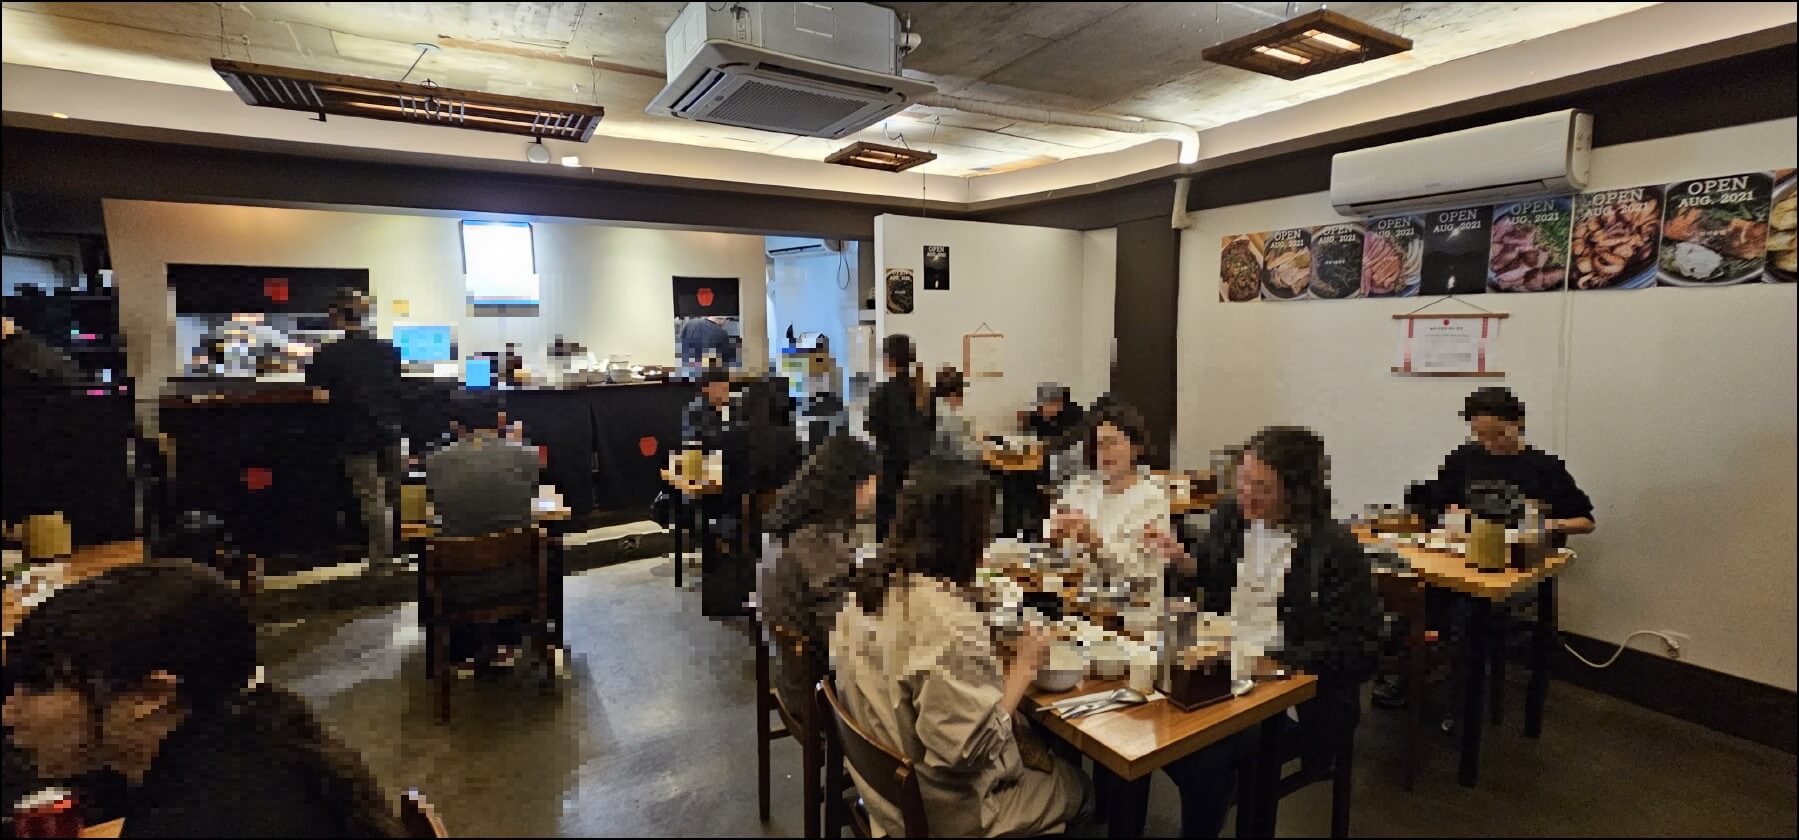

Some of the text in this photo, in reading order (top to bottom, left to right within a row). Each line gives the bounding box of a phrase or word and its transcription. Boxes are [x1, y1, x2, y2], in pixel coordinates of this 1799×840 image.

[1687, 176, 1750, 195] OPEN
[1592, 189, 1645, 206] OPEN
[1678, 191, 1754, 209] AUG. 2021
[1511, 200, 1555, 216] OPEN
[1439, 209, 1479, 223] OPEN
[1534, 212, 1559, 223] 2021
[1377, 217, 1412, 230] OPEN
[1459, 220, 1481, 231] 2021
[1274, 230, 1302, 241] OPEN
[1323, 224, 1354, 236] OPEN
[1395, 228, 1415, 237] 2021
[1338, 234, 1356, 242] 2021
